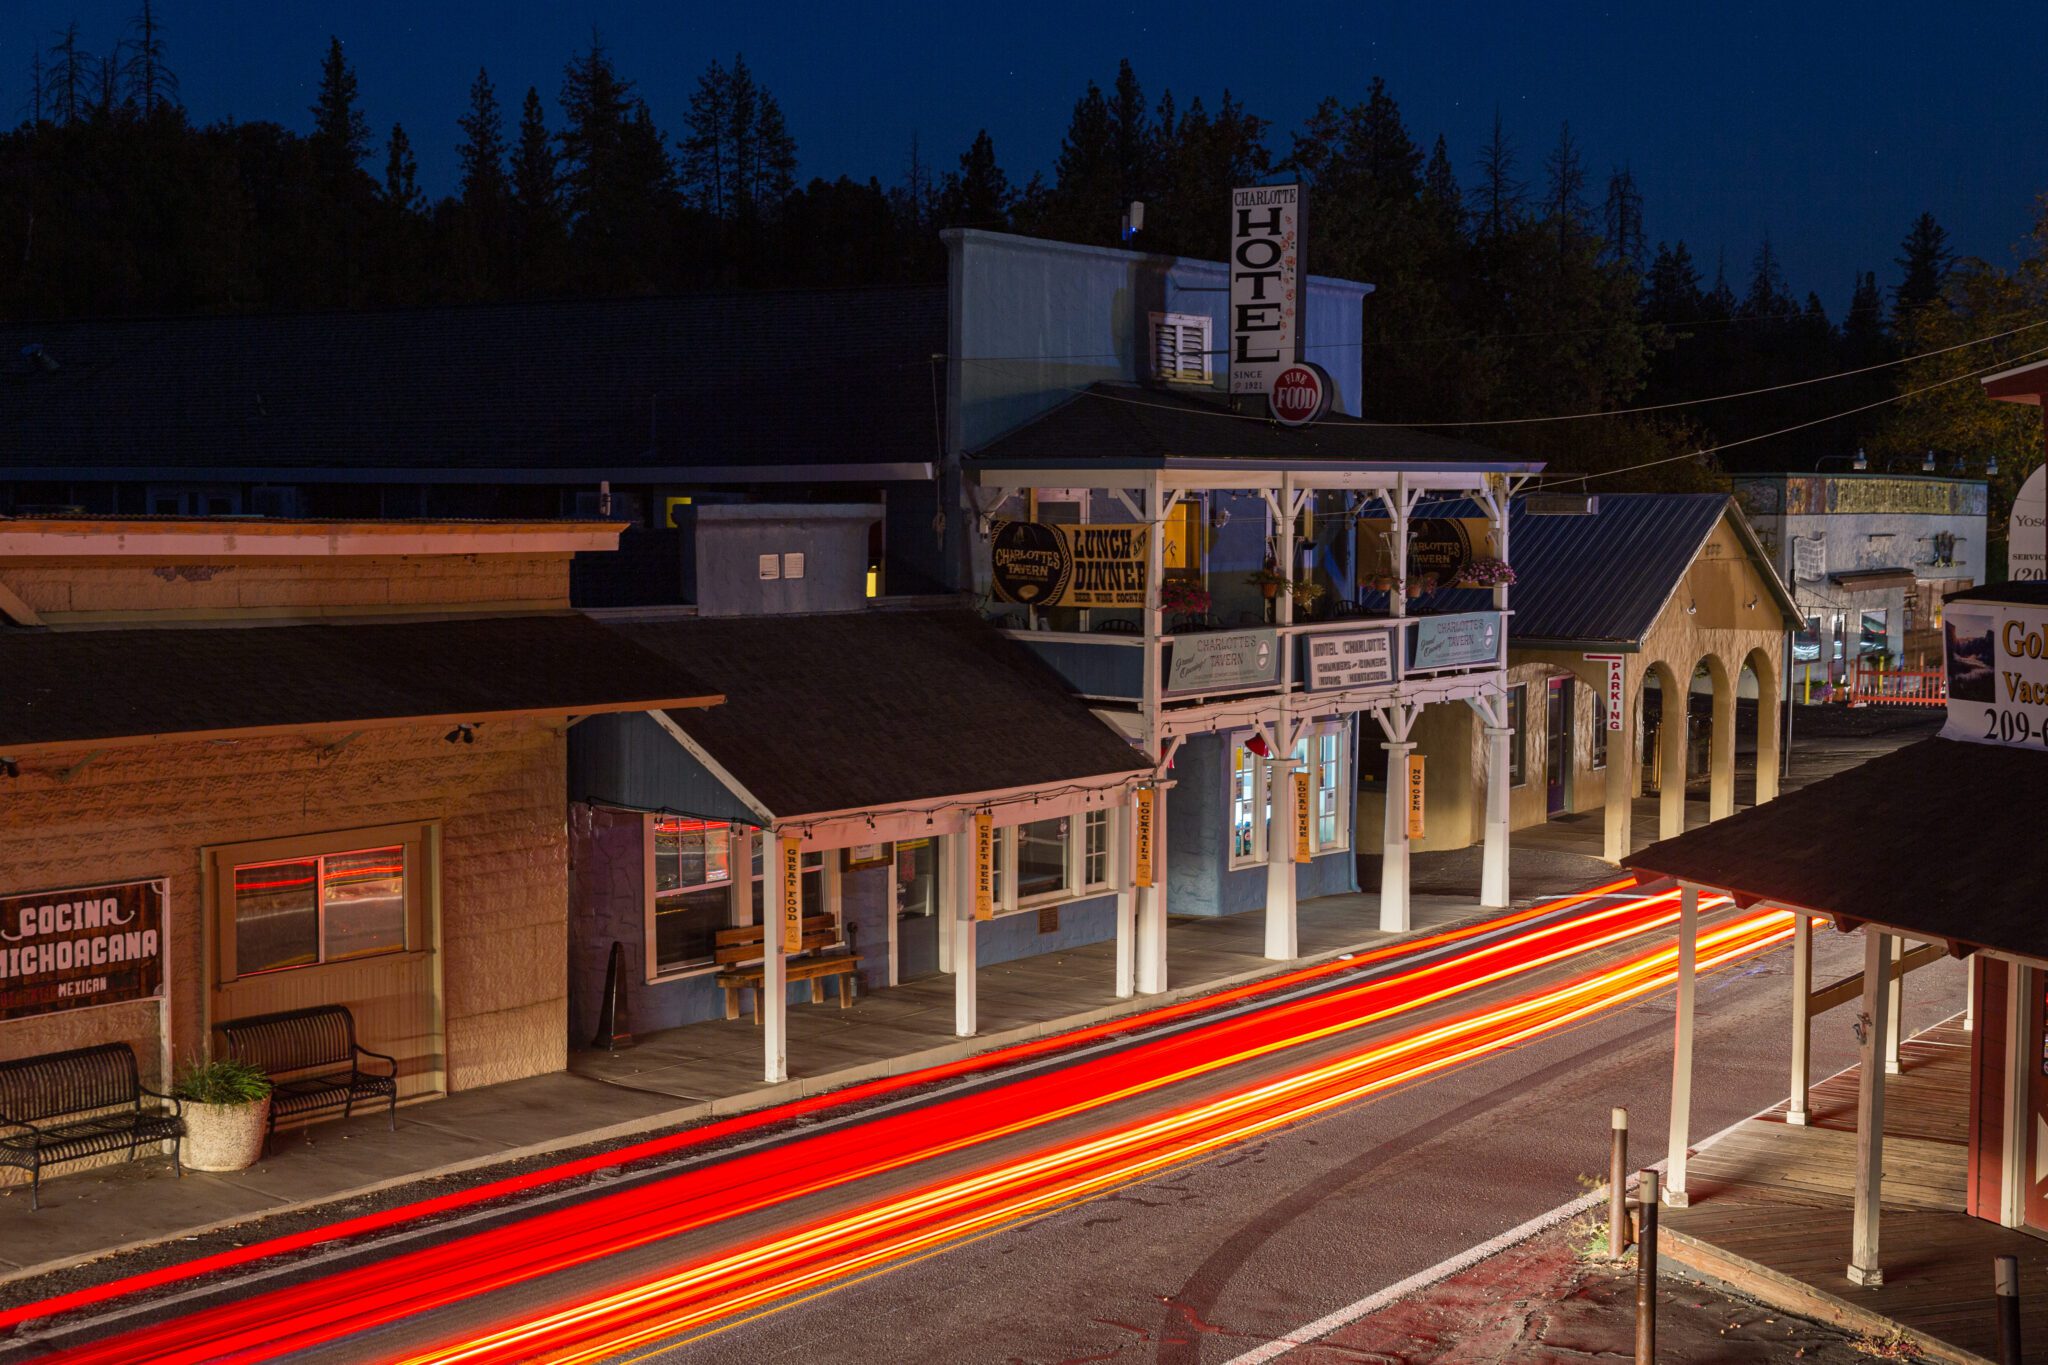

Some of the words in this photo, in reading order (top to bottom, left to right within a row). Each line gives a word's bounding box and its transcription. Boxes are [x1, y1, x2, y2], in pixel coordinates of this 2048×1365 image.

[1234, 188, 1297, 206] CHARLOTTE
[1235, 207, 1282, 363] HOTEL
[1234, 370, 1263, 380] SINCE
[1284, 372, 1308, 385] FINE
[1276, 386, 1316, 410] FOOD
[1074, 529, 1131, 559] LUNCH
[2012, 553, 2046, 561] SERVIC
[1007, 563, 1048, 577] TAVERN
[1074, 560, 1145, 591] DINNER
[1313, 642, 1338, 657] HOTEL
[1343, 638, 1387, 654] CHARLOTTE
[1447, 634, 1475, 647] TAVERN
[1210, 652, 1243, 667] TAVERN
[1609, 661, 1621, 730] PARKING
[1412, 768, 1421, 785] NOW
[1298, 780, 1306, 810] LOCAL
[1412, 789, 1421, 811] OPEN
[1140, 801, 1150, 860] COCKTAILS
[1298, 813, 1308, 837] WINE
[980, 825, 989, 860] CRAFT
[787, 848, 797, 886] GREAT
[980, 863, 989, 891] BEER
[787, 891, 798, 921] FOOD
[4, 897, 133, 941] COCINA
[58, 977, 107, 997] MEXICAN
